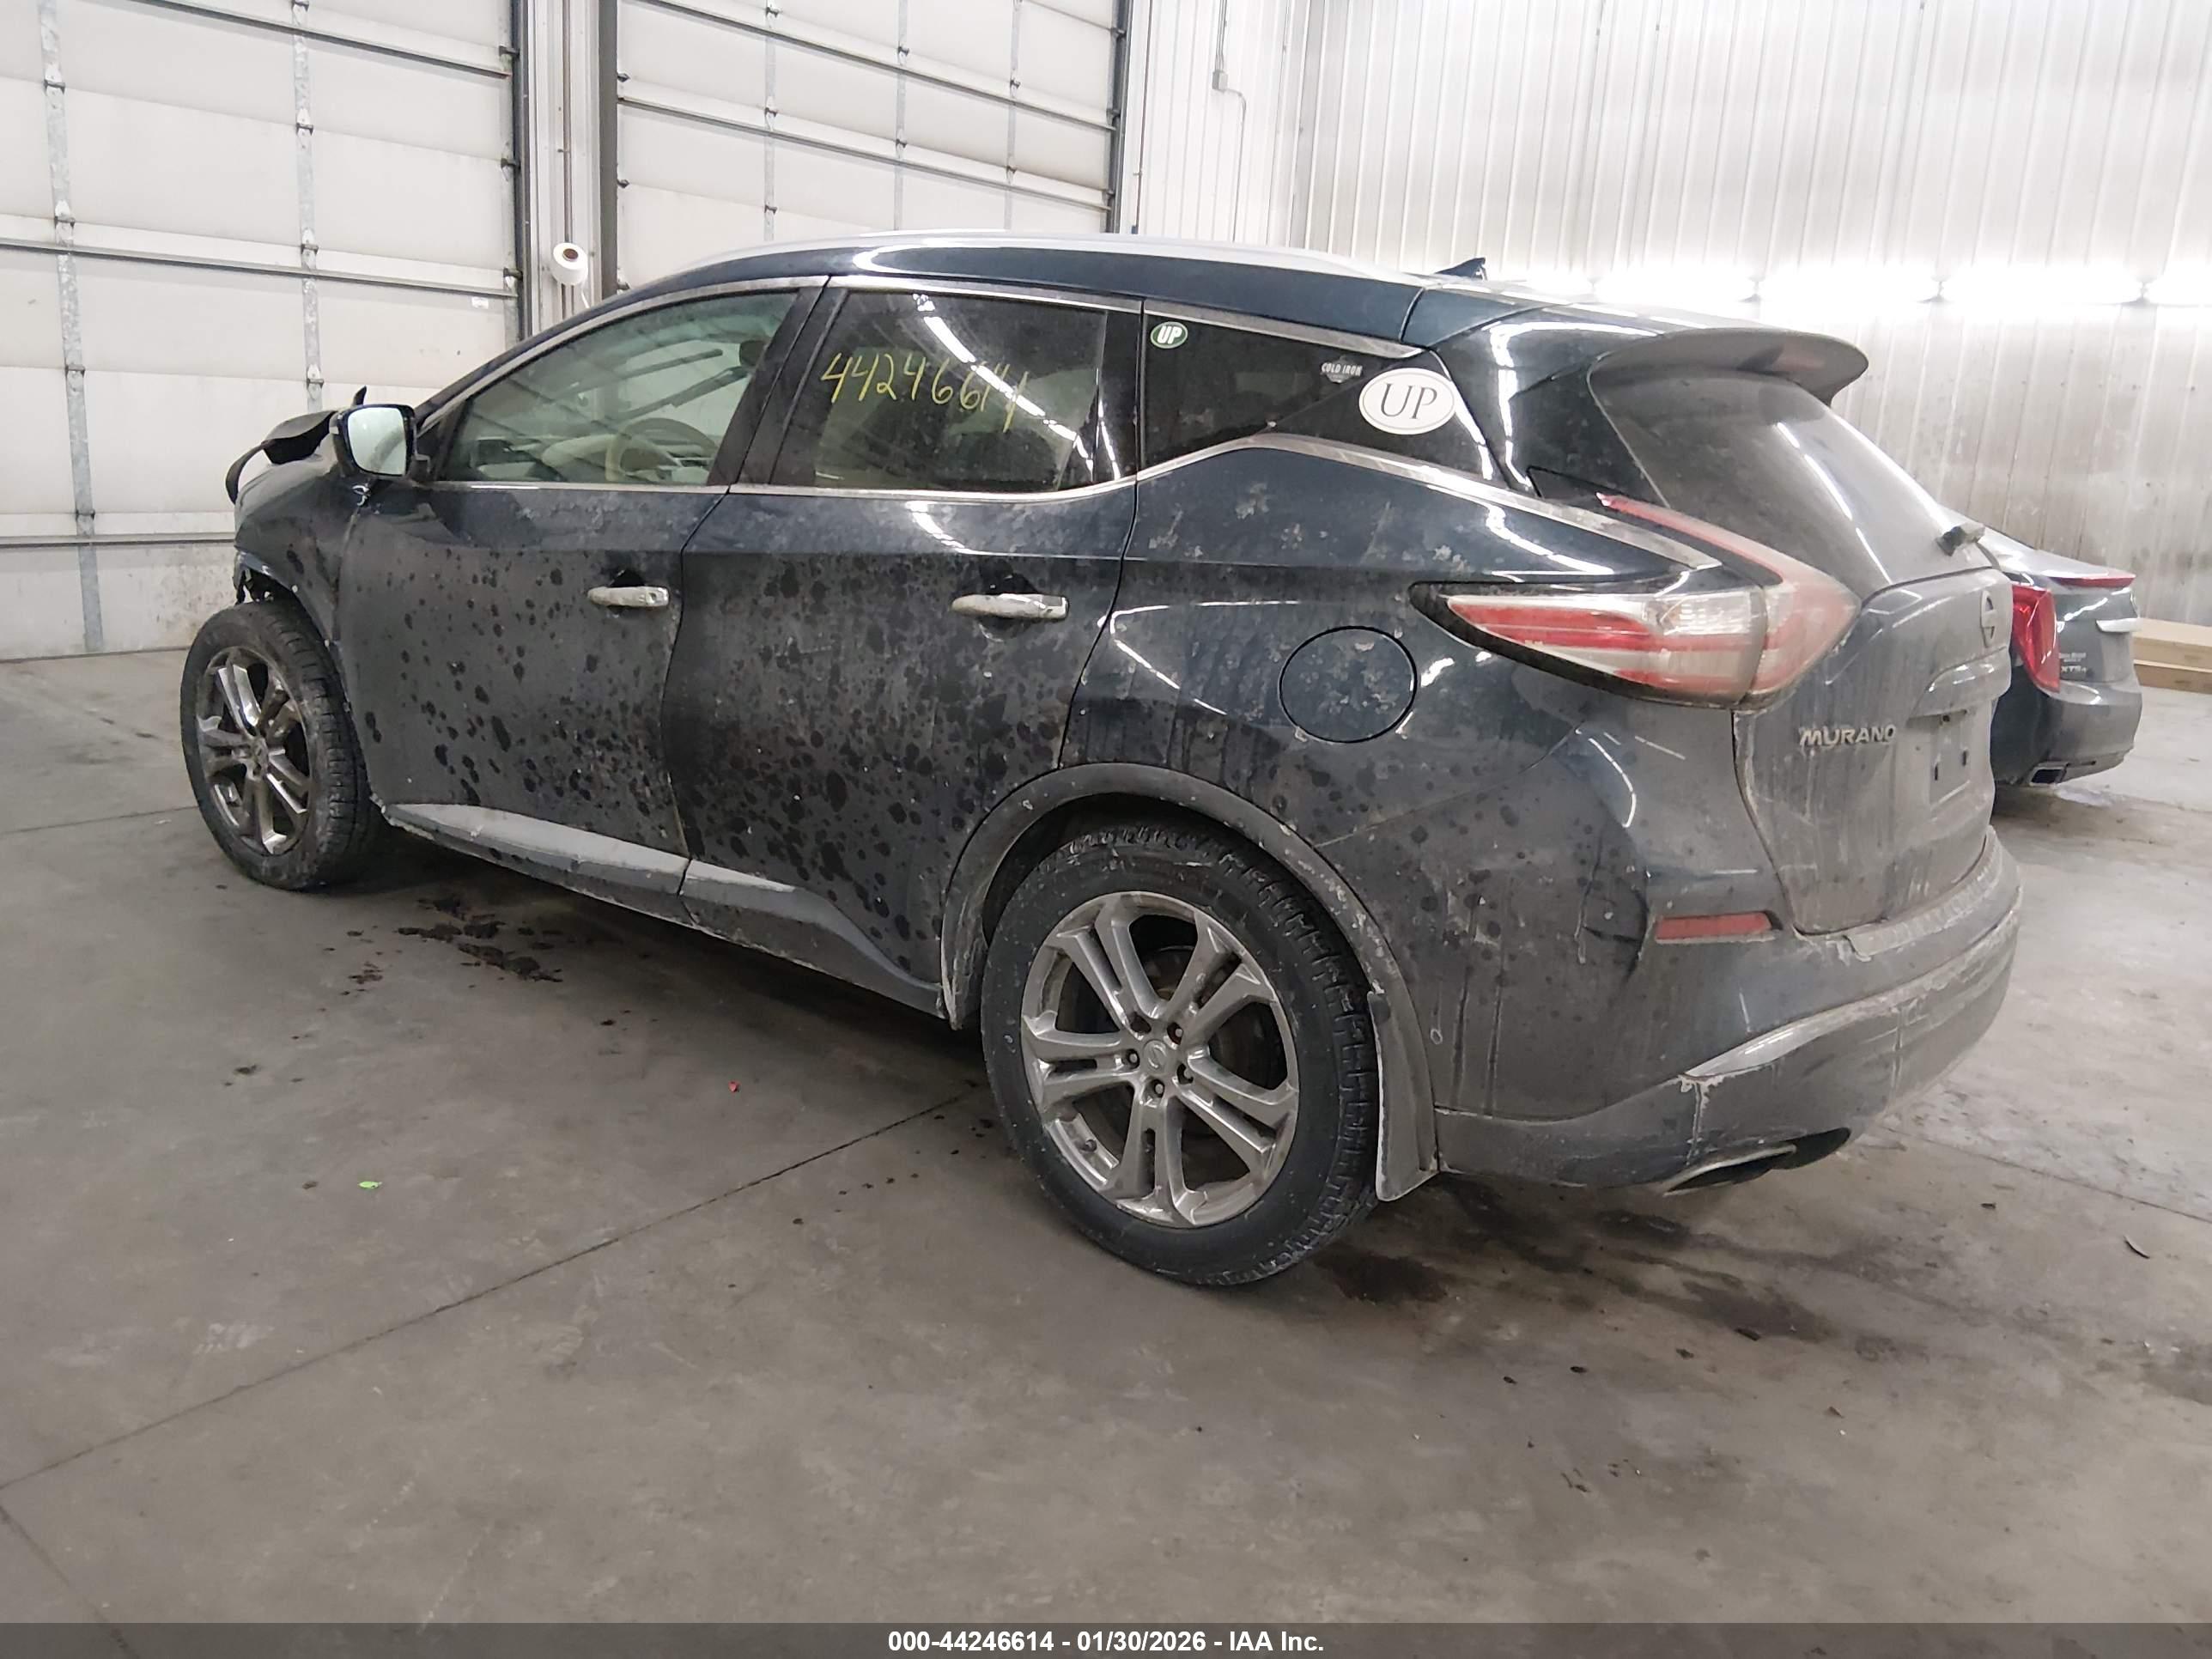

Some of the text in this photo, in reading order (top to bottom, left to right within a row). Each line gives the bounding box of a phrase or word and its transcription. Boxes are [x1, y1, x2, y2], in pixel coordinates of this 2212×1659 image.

[1157, 325, 1183, 344] UP
[1321, 362, 1363, 377] COLD IRON
[1380, 383, 1437, 420] UP
[1799, 725, 1896, 747] MURANO
